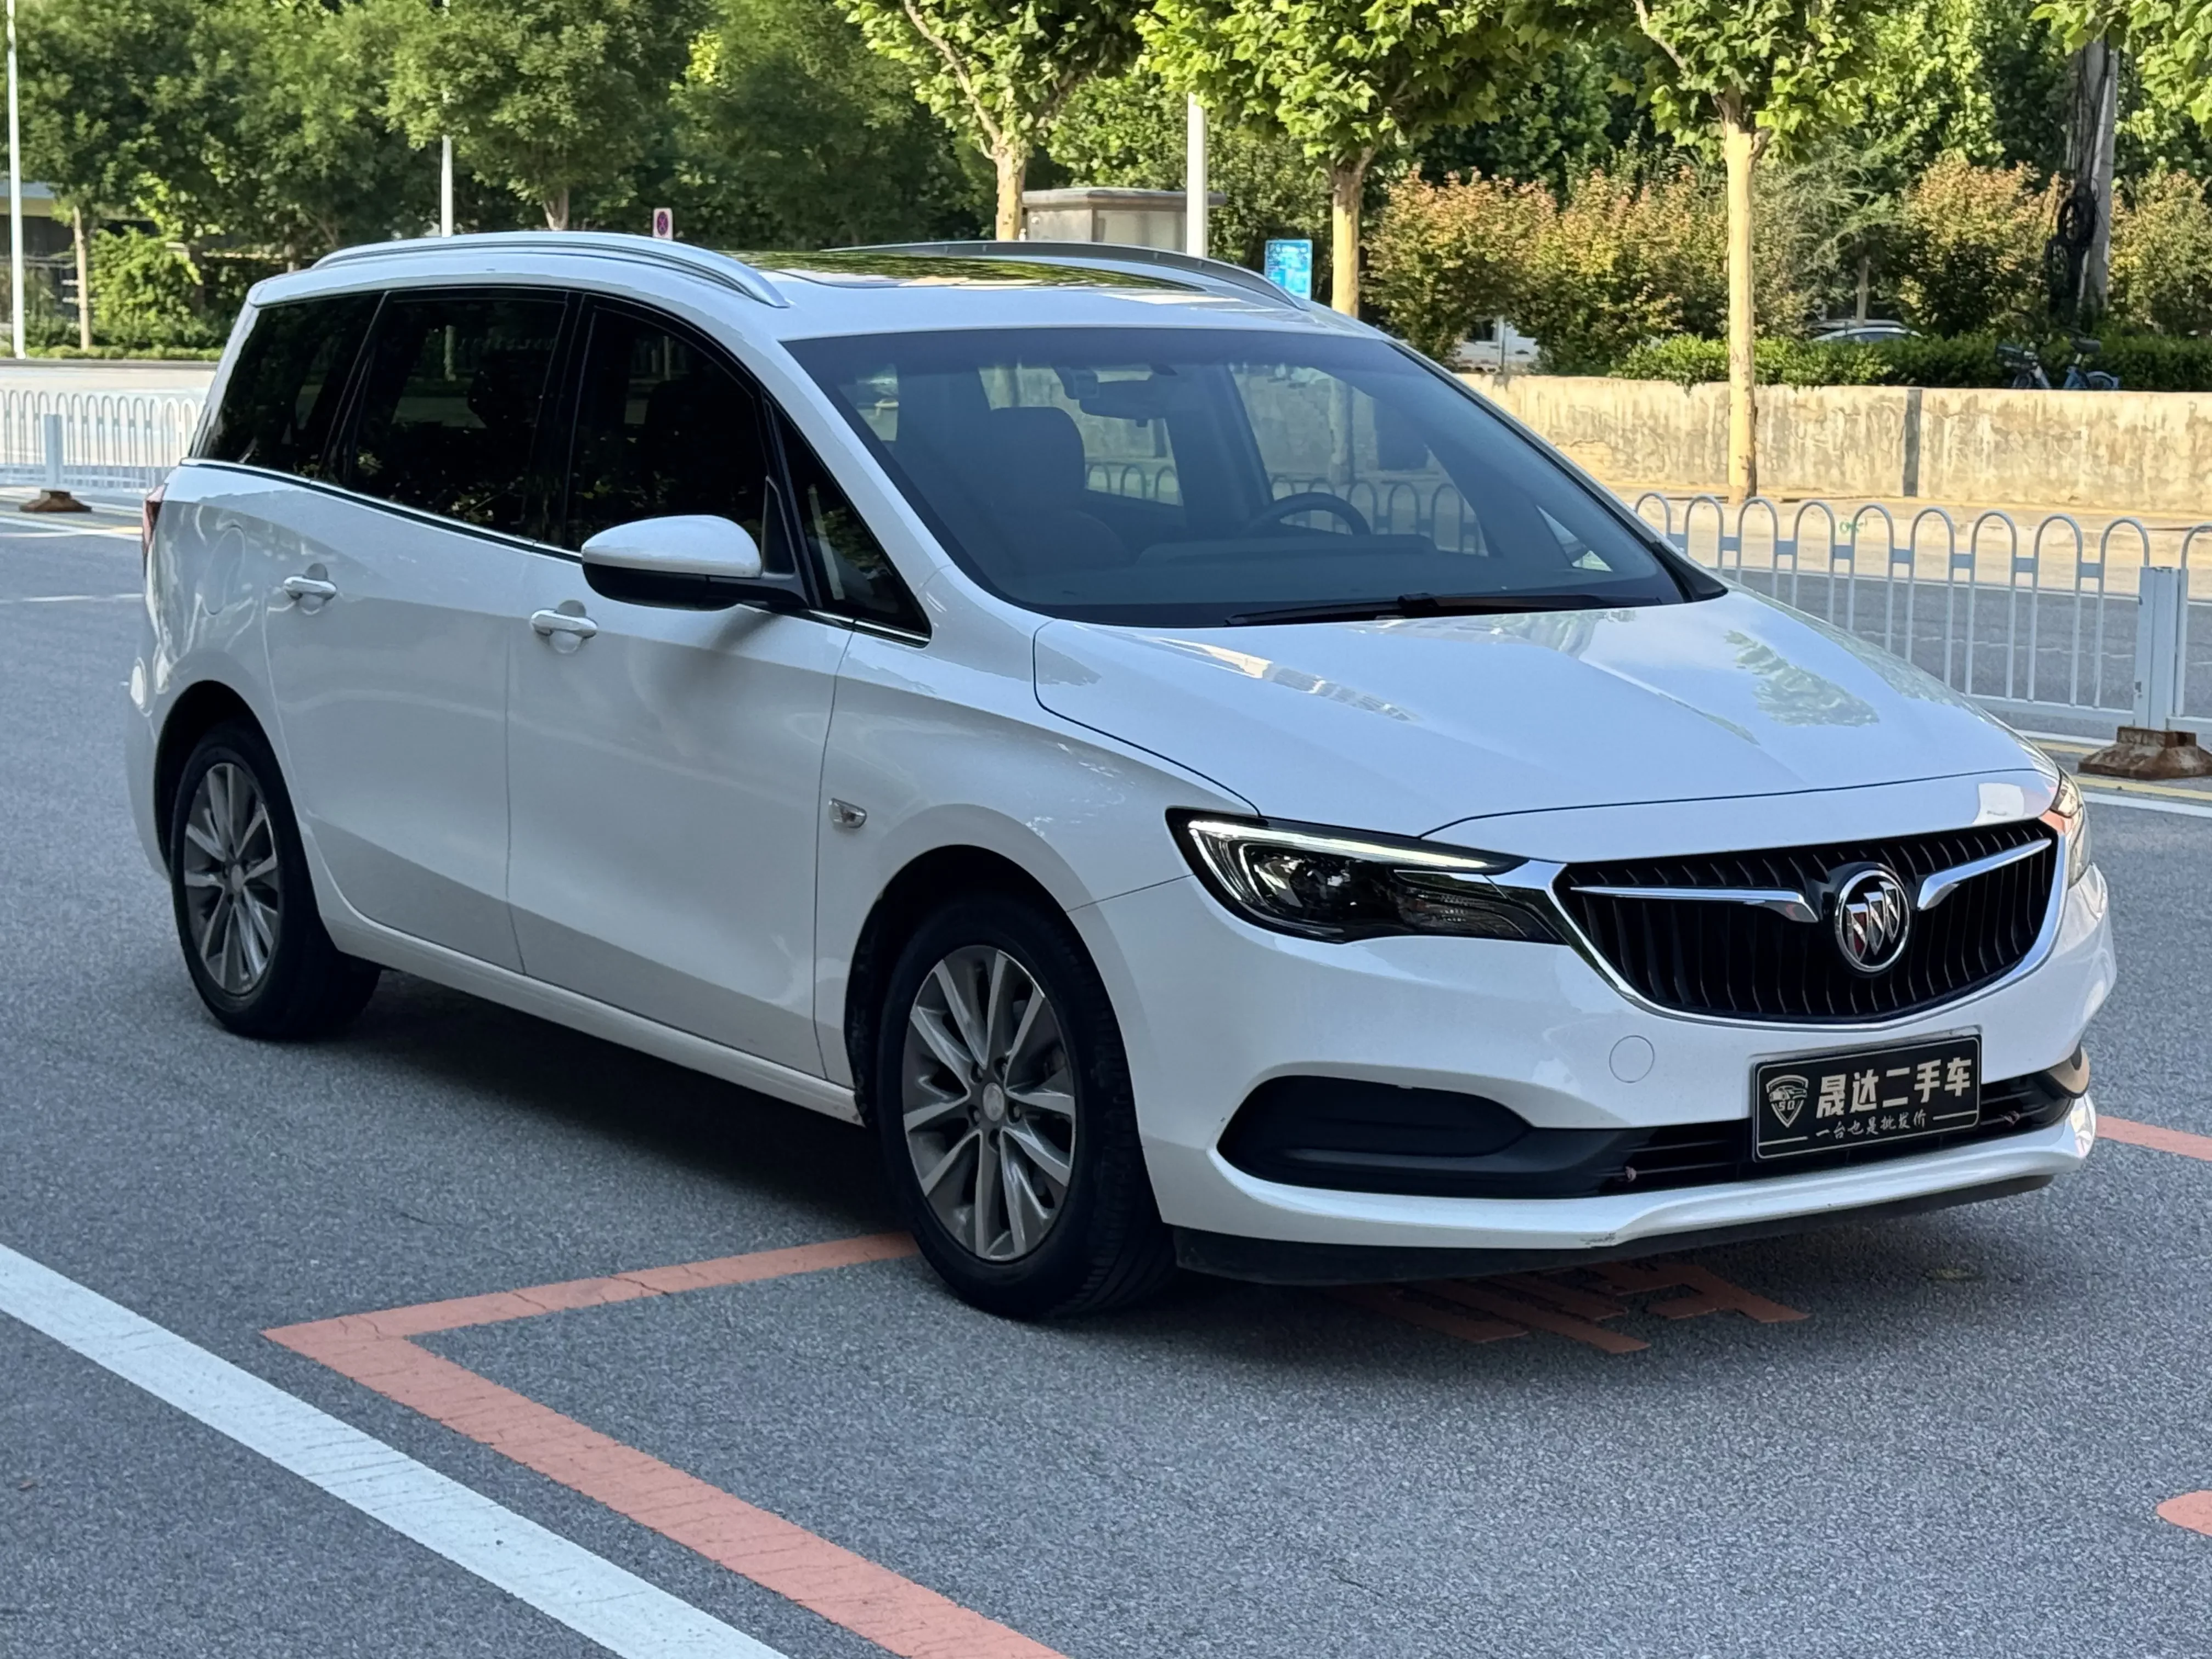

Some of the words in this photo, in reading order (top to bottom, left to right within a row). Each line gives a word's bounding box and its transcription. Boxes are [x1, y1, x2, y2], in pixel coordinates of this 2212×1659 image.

[1816, 1057, 1972, 1119] 晟达二手车
[1815, 1109, 1926, 1139] 一台也是批发价
